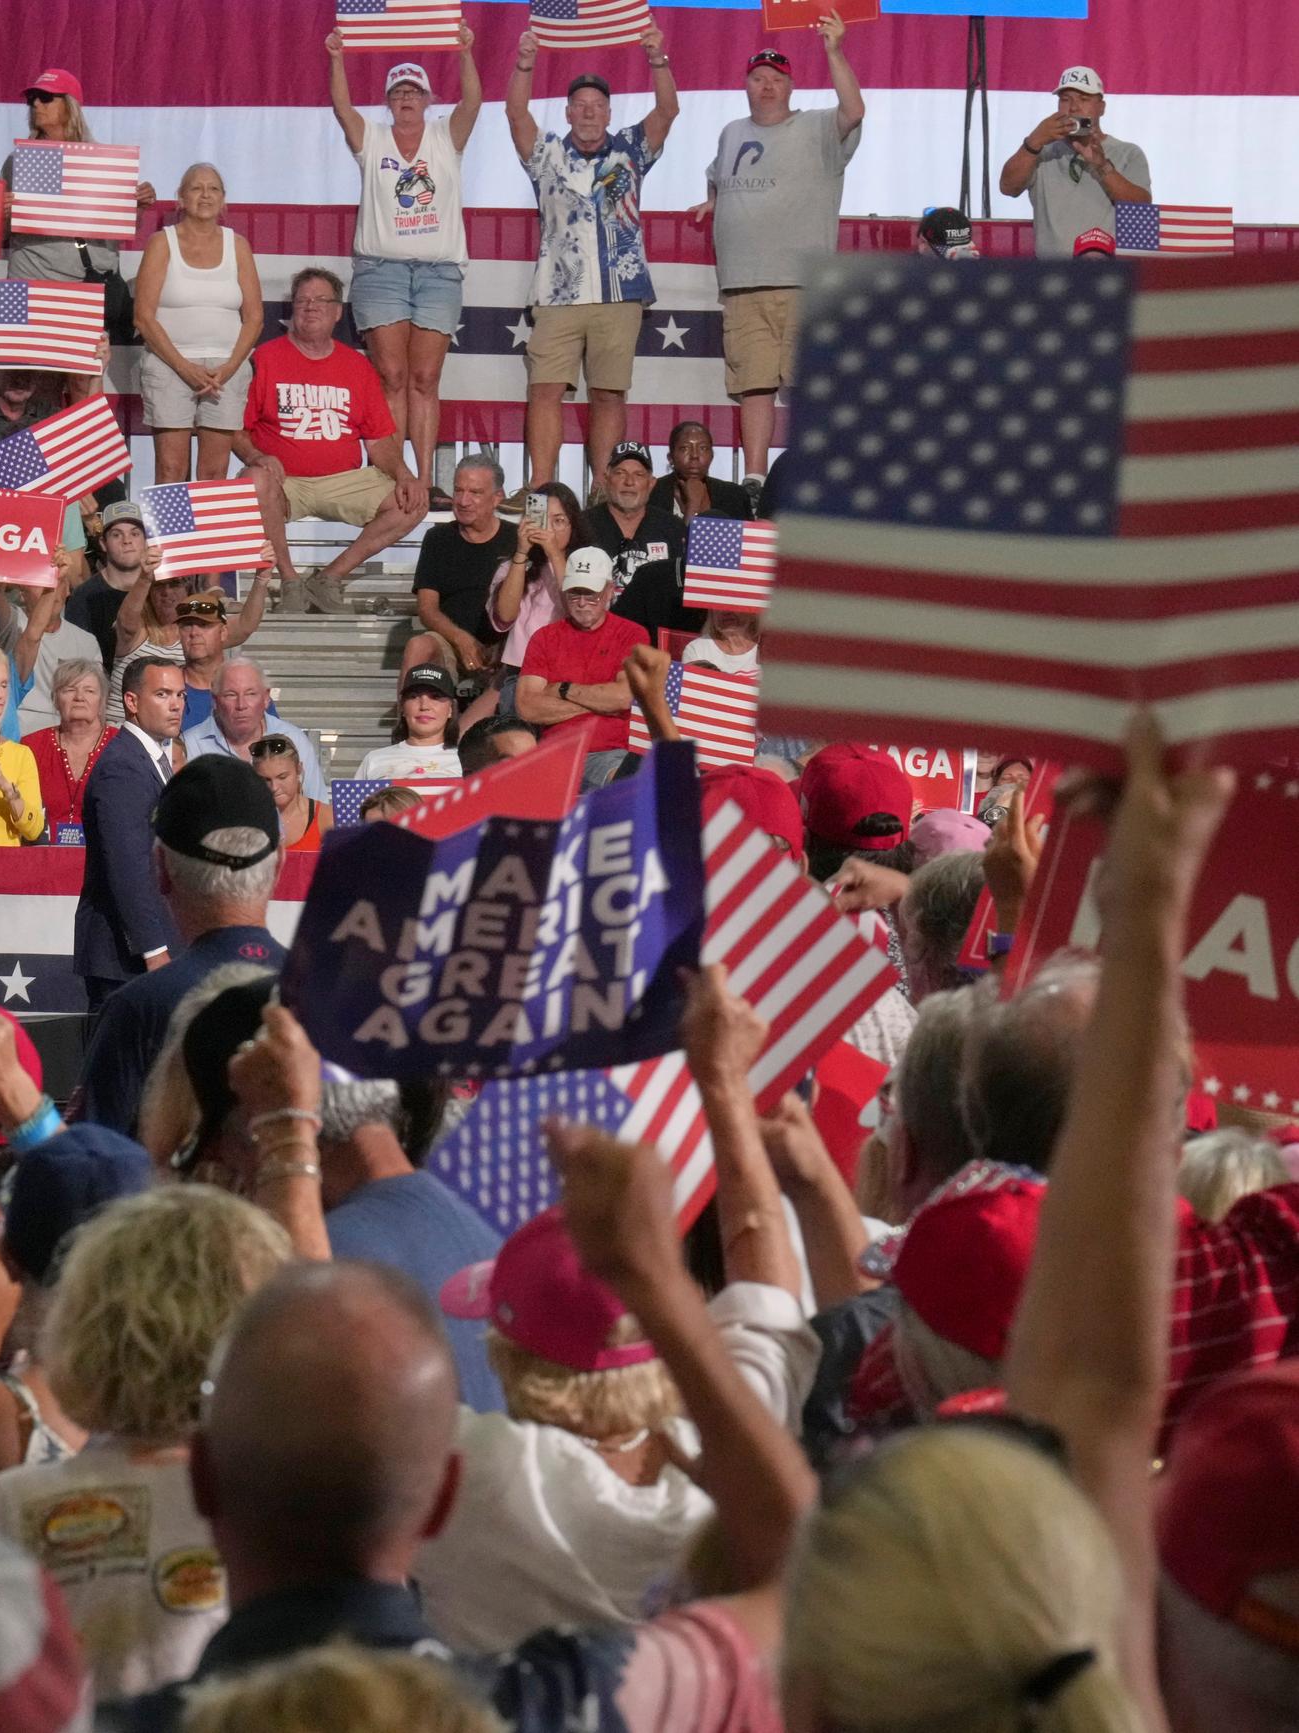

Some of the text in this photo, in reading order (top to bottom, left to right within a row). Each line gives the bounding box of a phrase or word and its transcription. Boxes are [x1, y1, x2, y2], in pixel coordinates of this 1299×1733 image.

[1061, 70, 1091, 85] USA
[394, 212, 440, 228] TRUMP GIRL
[276, 383, 351, 410] TRUMP
[292, 407, 342, 441] 2.0
[616, 441, 649, 459] USA
[651, 545, 665, 553] FRY
[868, 745, 954, 780] AGA
[419, 820, 634, 917] MAKE
[329, 847, 670, 962] AMERICA
[379, 921, 641, 1008] GREAT
[352, 969, 647, 1050] AGAIN!
